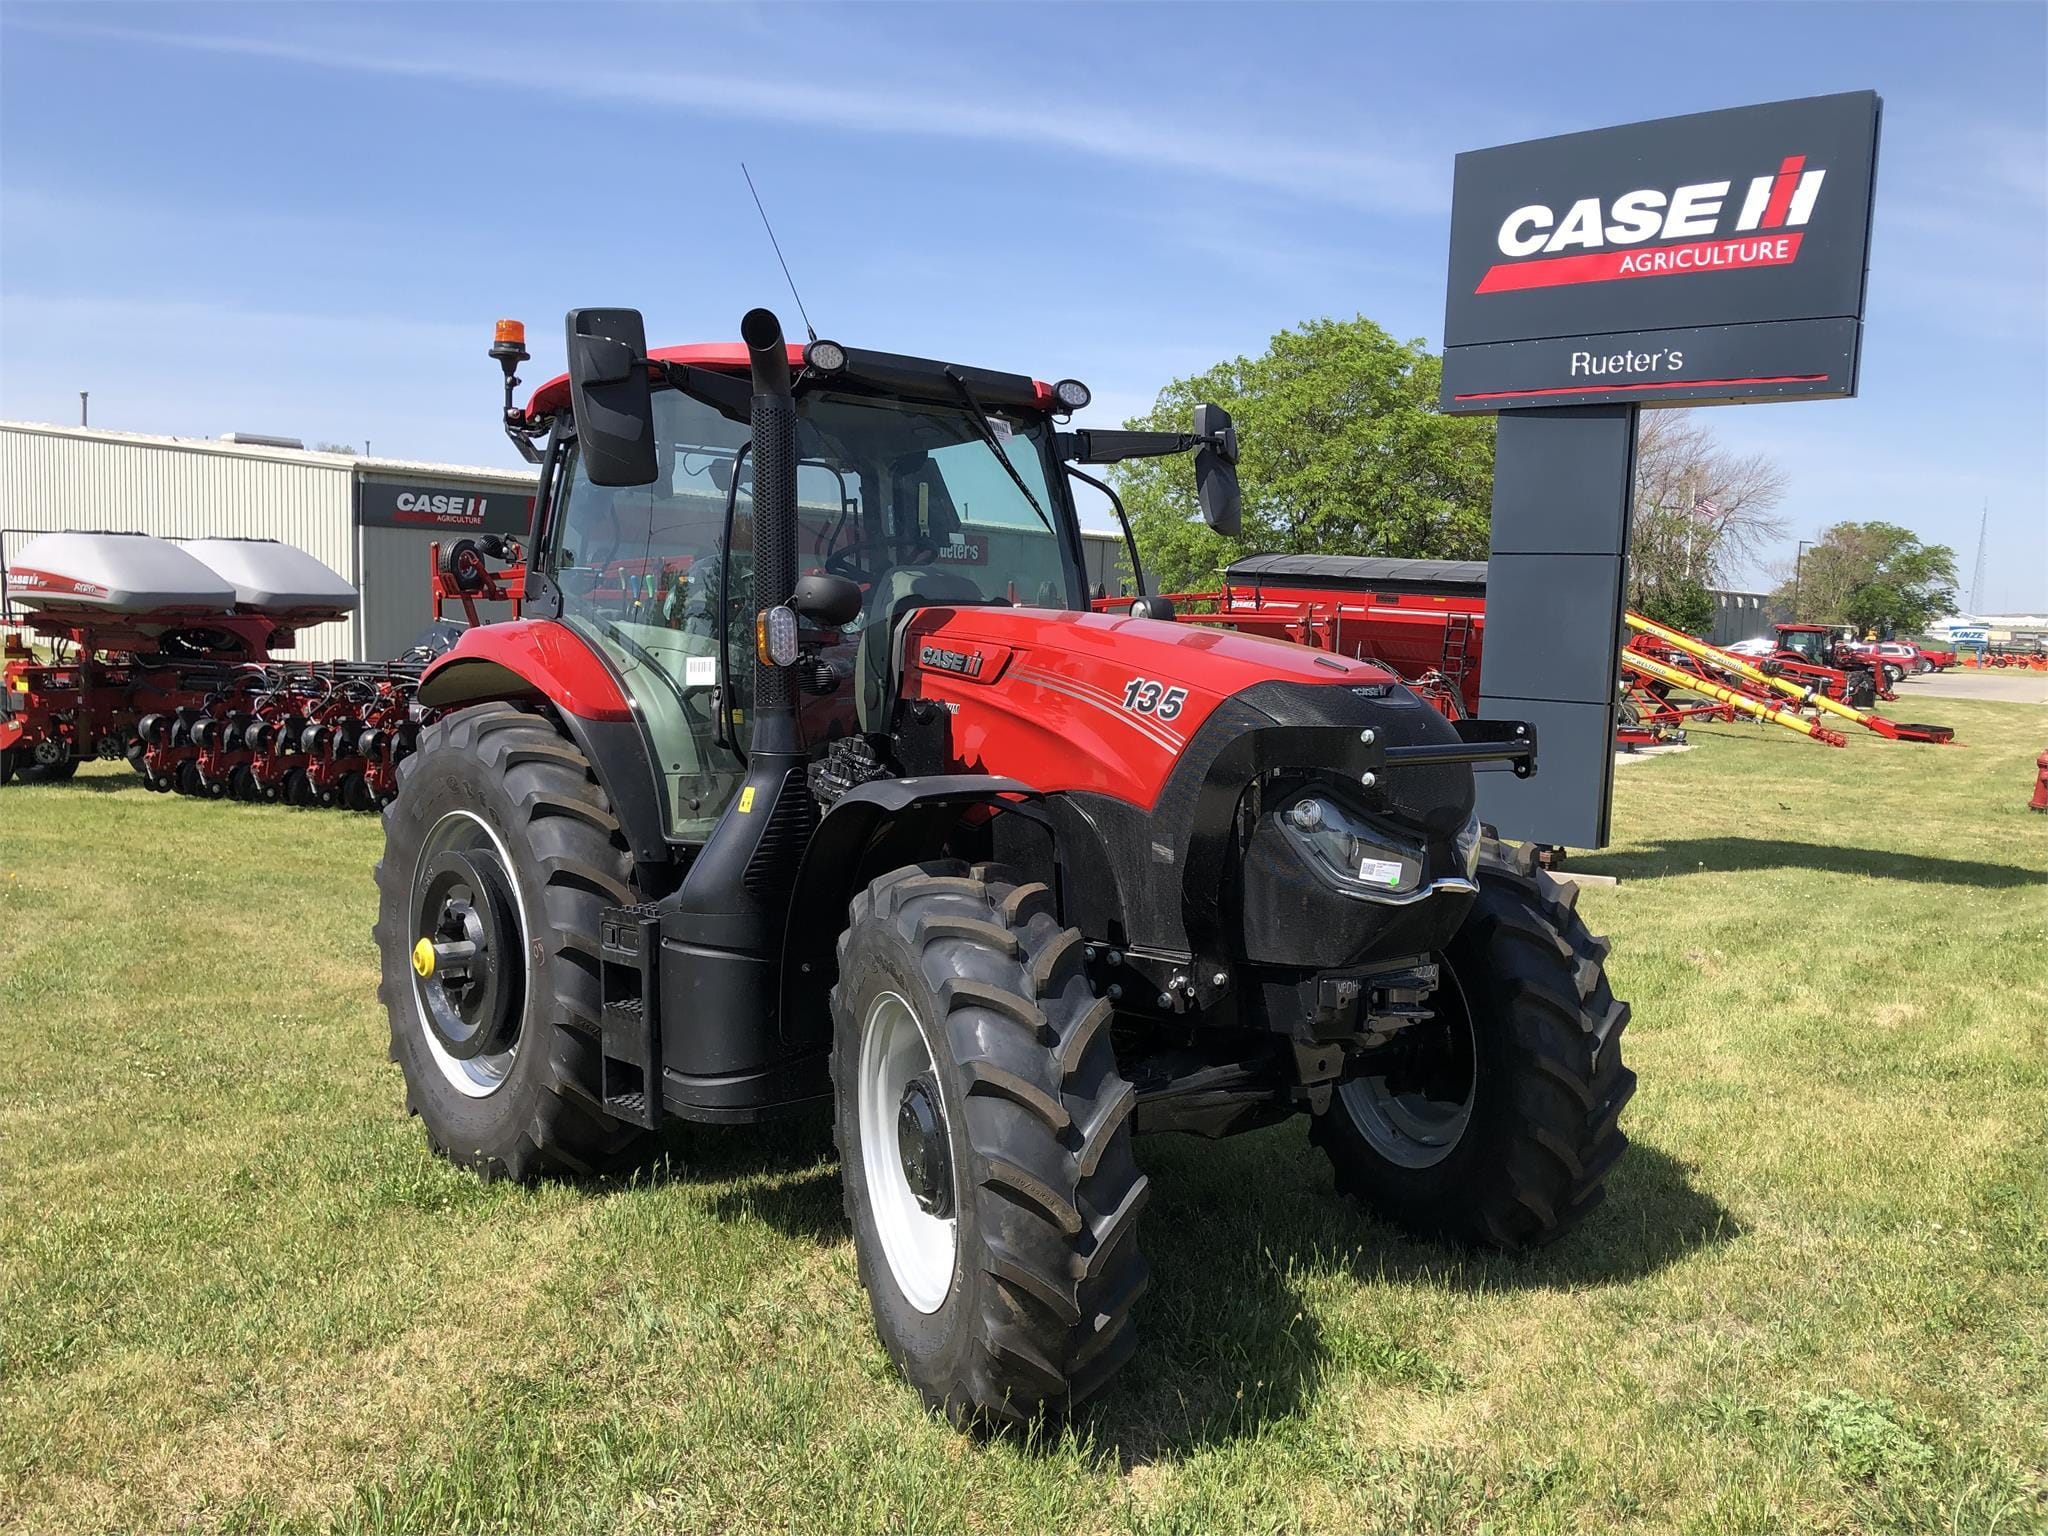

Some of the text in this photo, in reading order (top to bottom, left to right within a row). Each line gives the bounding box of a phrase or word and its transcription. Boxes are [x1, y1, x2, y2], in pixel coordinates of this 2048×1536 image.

[1497, 180, 1731, 257] CASE
[1619, 239, 1789, 273] AGRICULTURE
[1571, 348, 1683, 376] Rueter's
[396, 492, 464, 514] CASE
[436, 514, 481, 524] AGRICULTURE
[937, 543, 979, 560] ueter's
[1951, 631, 1986, 639] KINZE
[921, 646, 965, 671] CASE
[1122, 677, 1189, 721] 135
[1355, 687, 1378, 696] CASE
